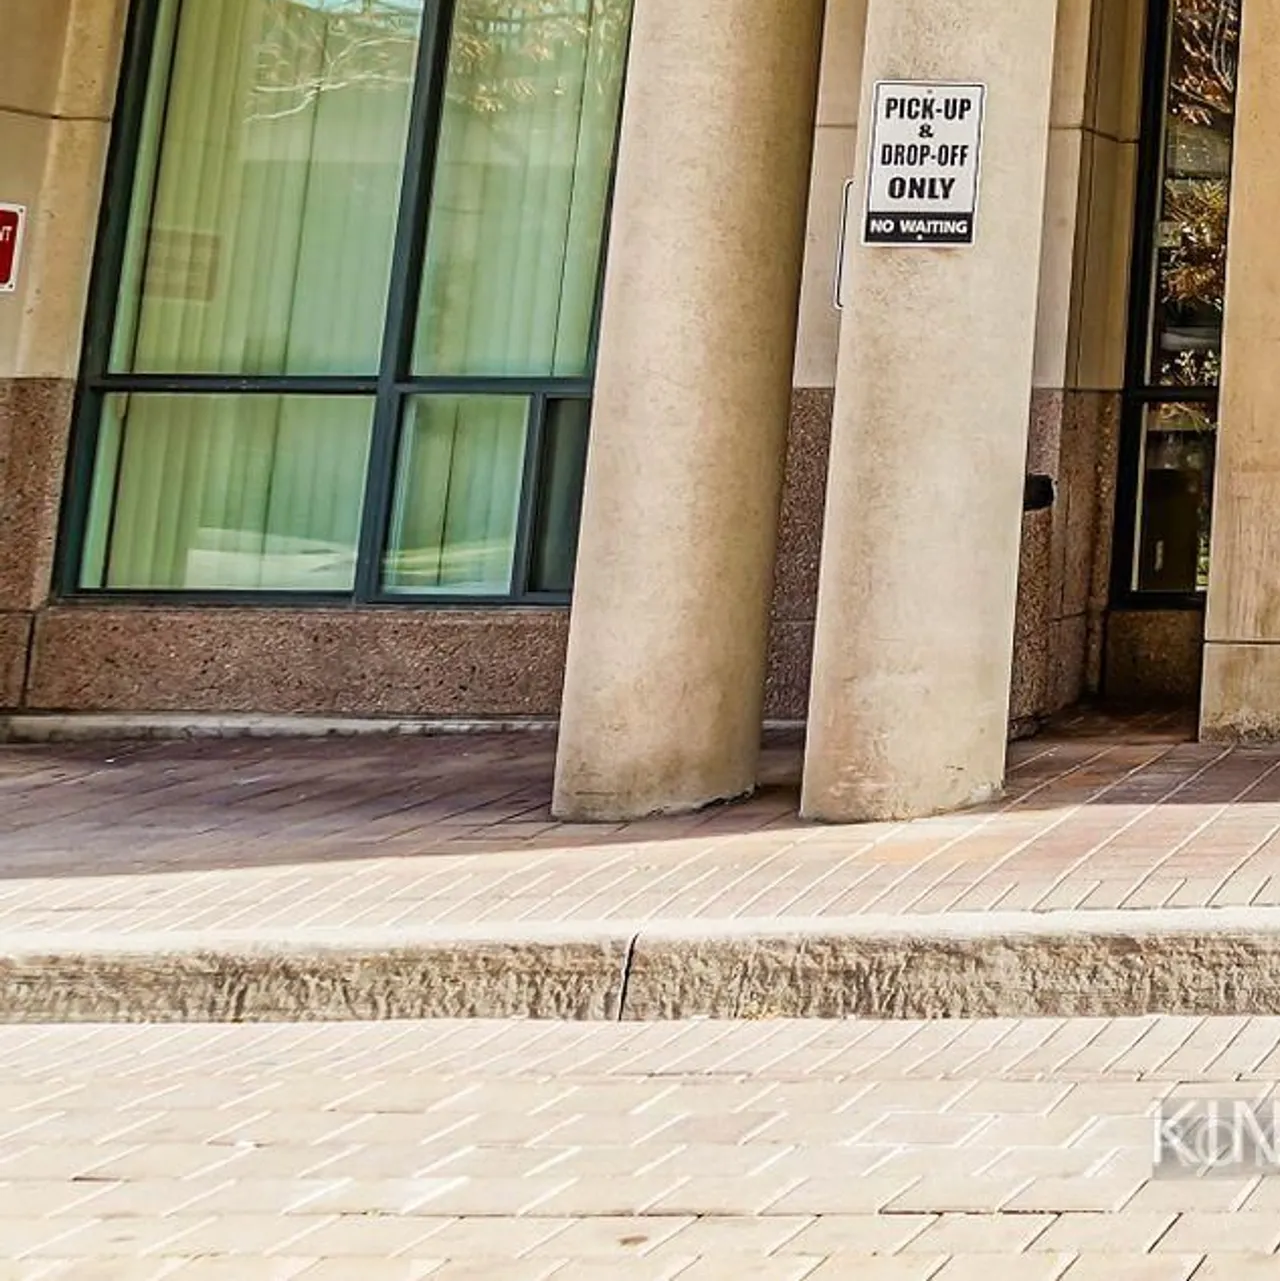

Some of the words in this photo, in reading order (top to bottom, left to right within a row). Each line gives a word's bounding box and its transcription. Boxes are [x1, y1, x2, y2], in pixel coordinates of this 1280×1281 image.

[885, 98, 972, 120] PICK-UP
[918, 124, 934, 138] &
[881, 144, 970, 166] DROP-OFF
[887, 177, 956, 199] ONLY
[870, 219, 895, 234] NO
[900, 219, 968, 234] WAITING
